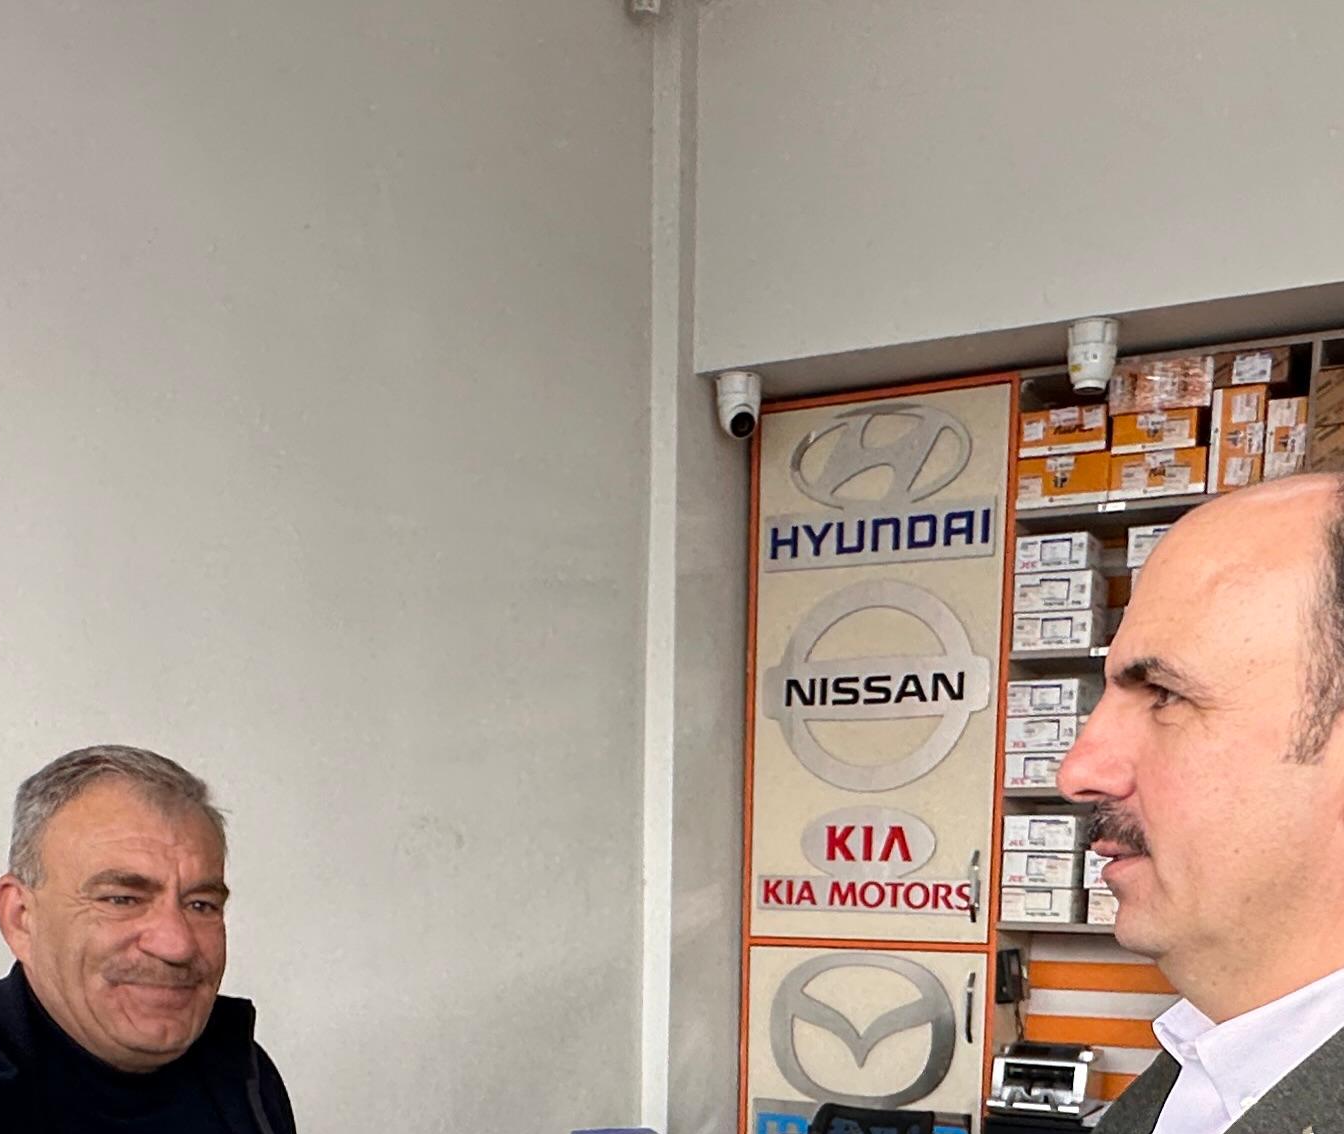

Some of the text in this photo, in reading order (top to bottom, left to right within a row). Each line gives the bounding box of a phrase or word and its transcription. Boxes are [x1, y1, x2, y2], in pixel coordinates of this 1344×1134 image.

[770, 508, 992, 560] HYUNDAI
[784, 671, 966, 707] NISSAN
[826, 825, 913, 862] KIA
[762, 879, 973, 911] KIA MOTORS
